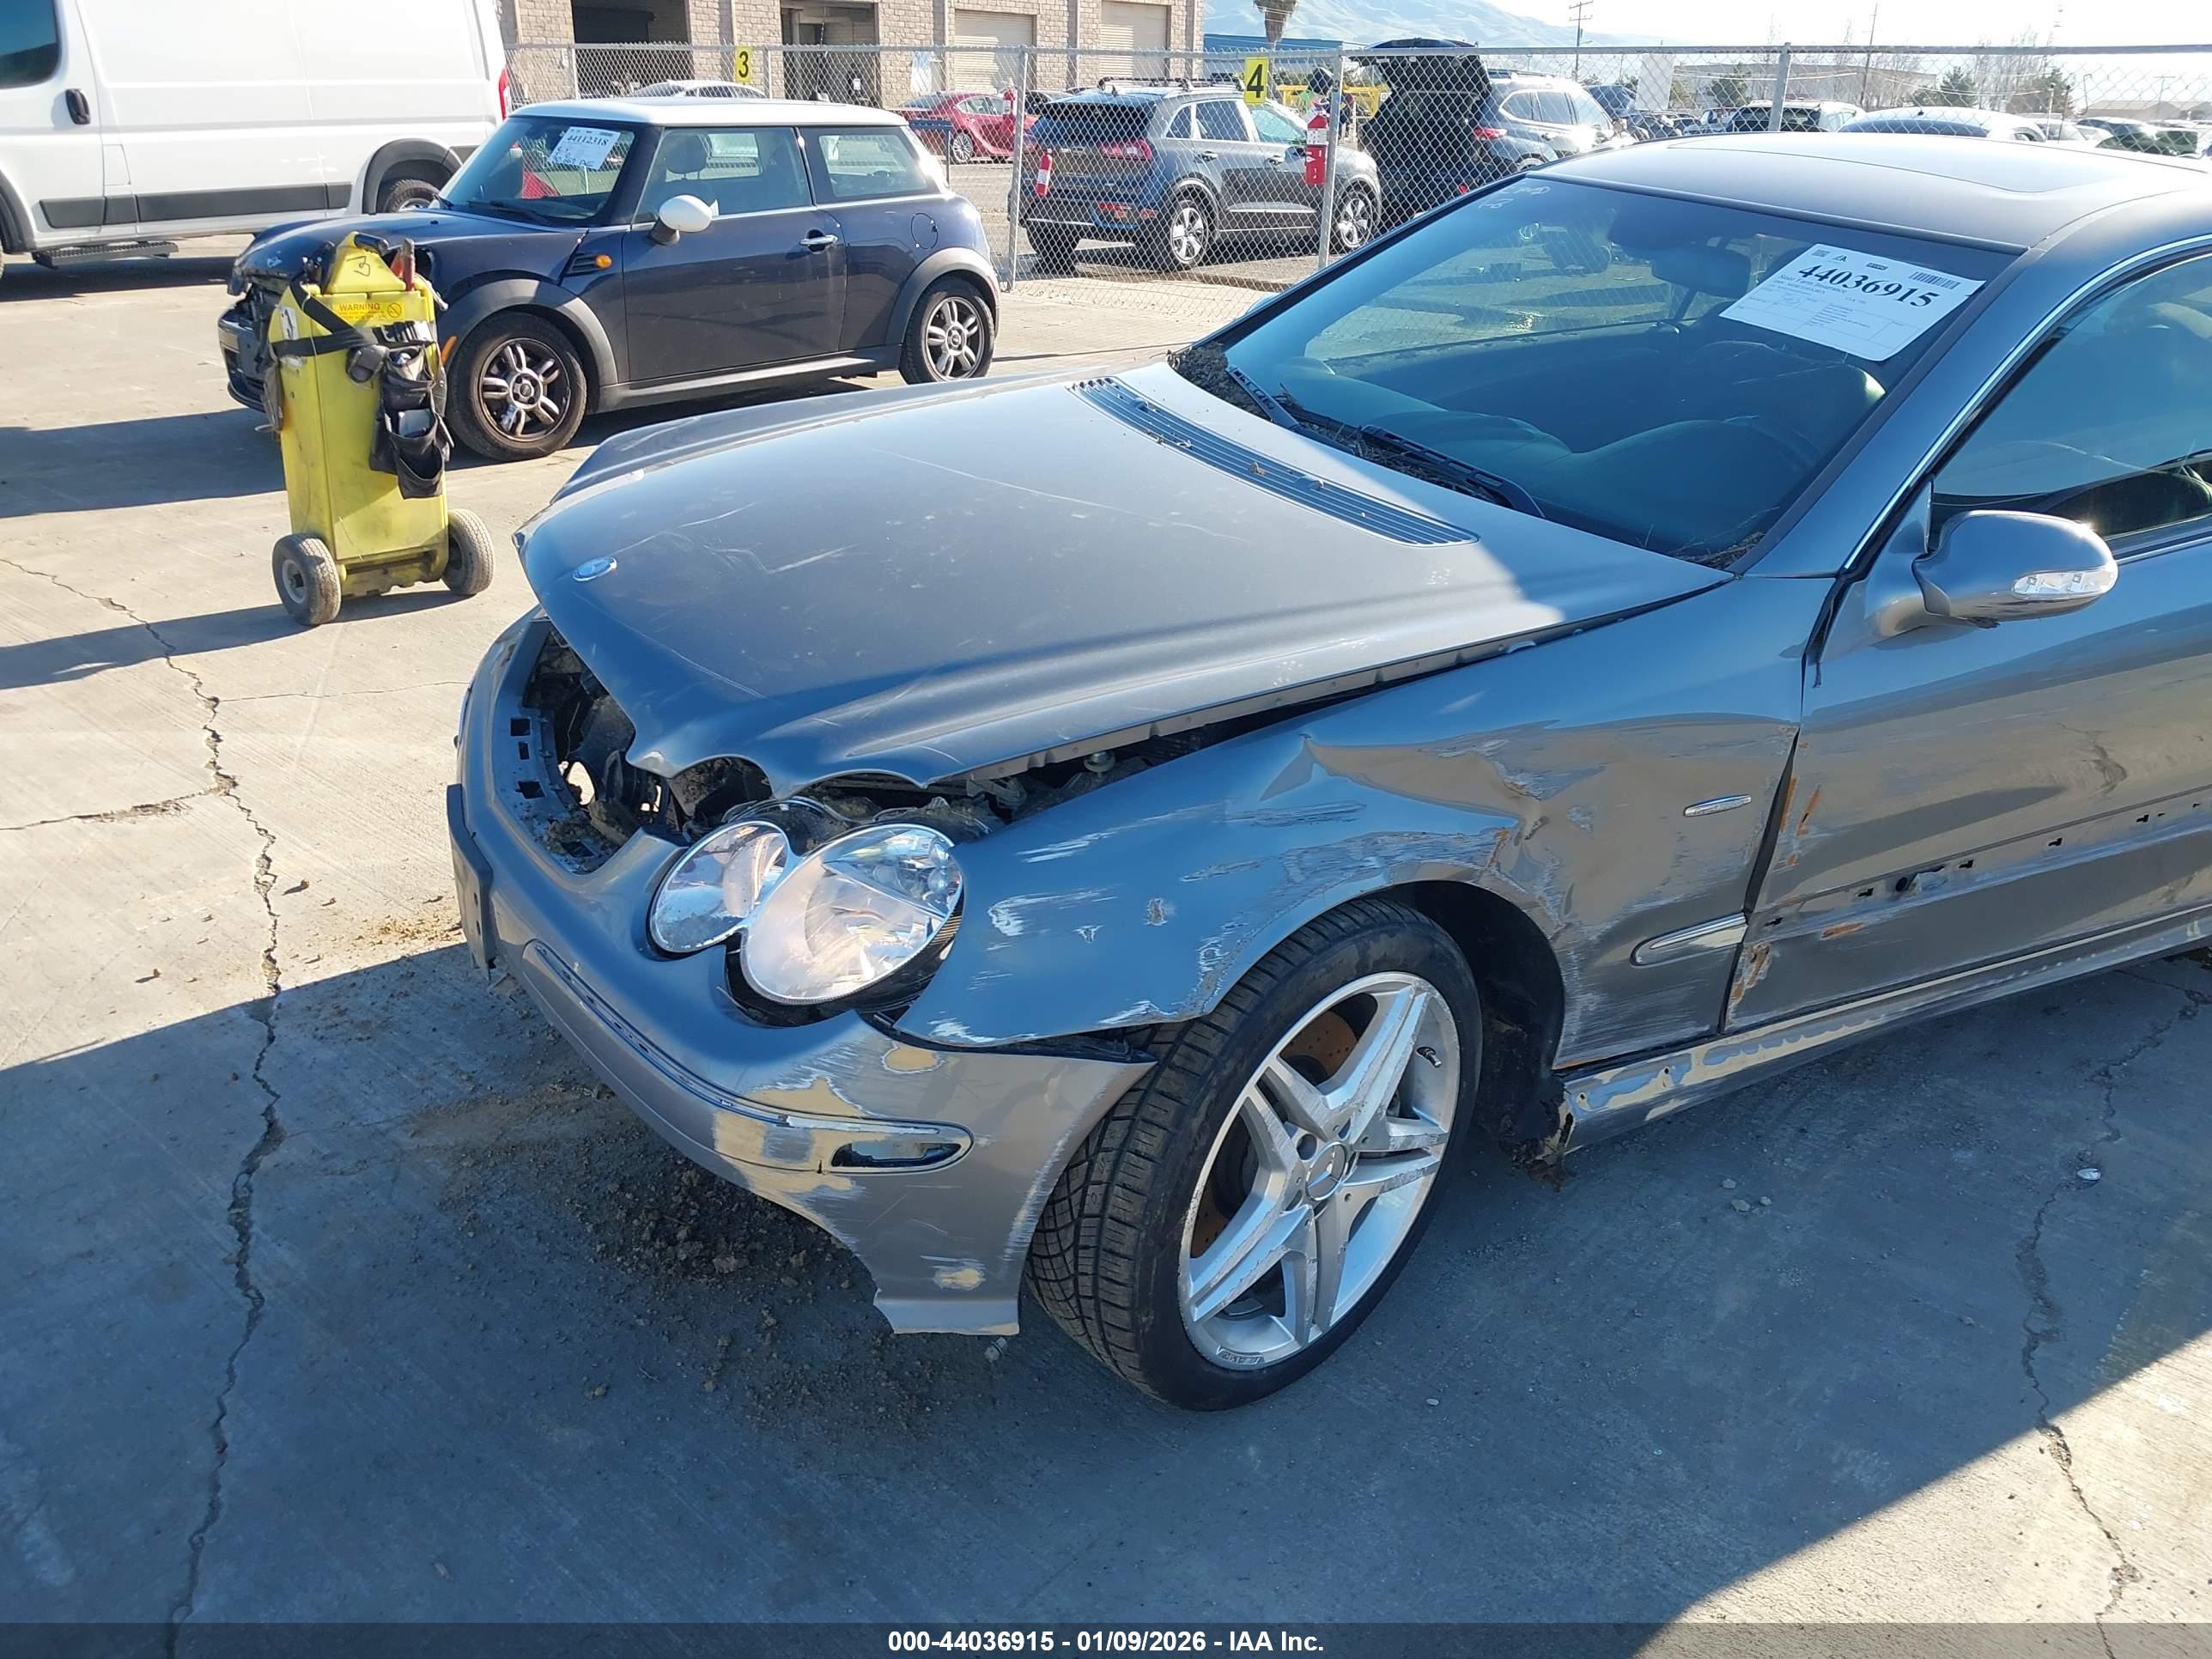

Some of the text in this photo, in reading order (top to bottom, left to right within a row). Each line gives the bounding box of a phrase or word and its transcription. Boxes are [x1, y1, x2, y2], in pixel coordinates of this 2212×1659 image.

[738, 51, 749, 78] 3
[1246, 64, 1264, 99] 4
[568, 135, 609, 146] 44112318
[1798, 264, 1942, 307] 44036915
